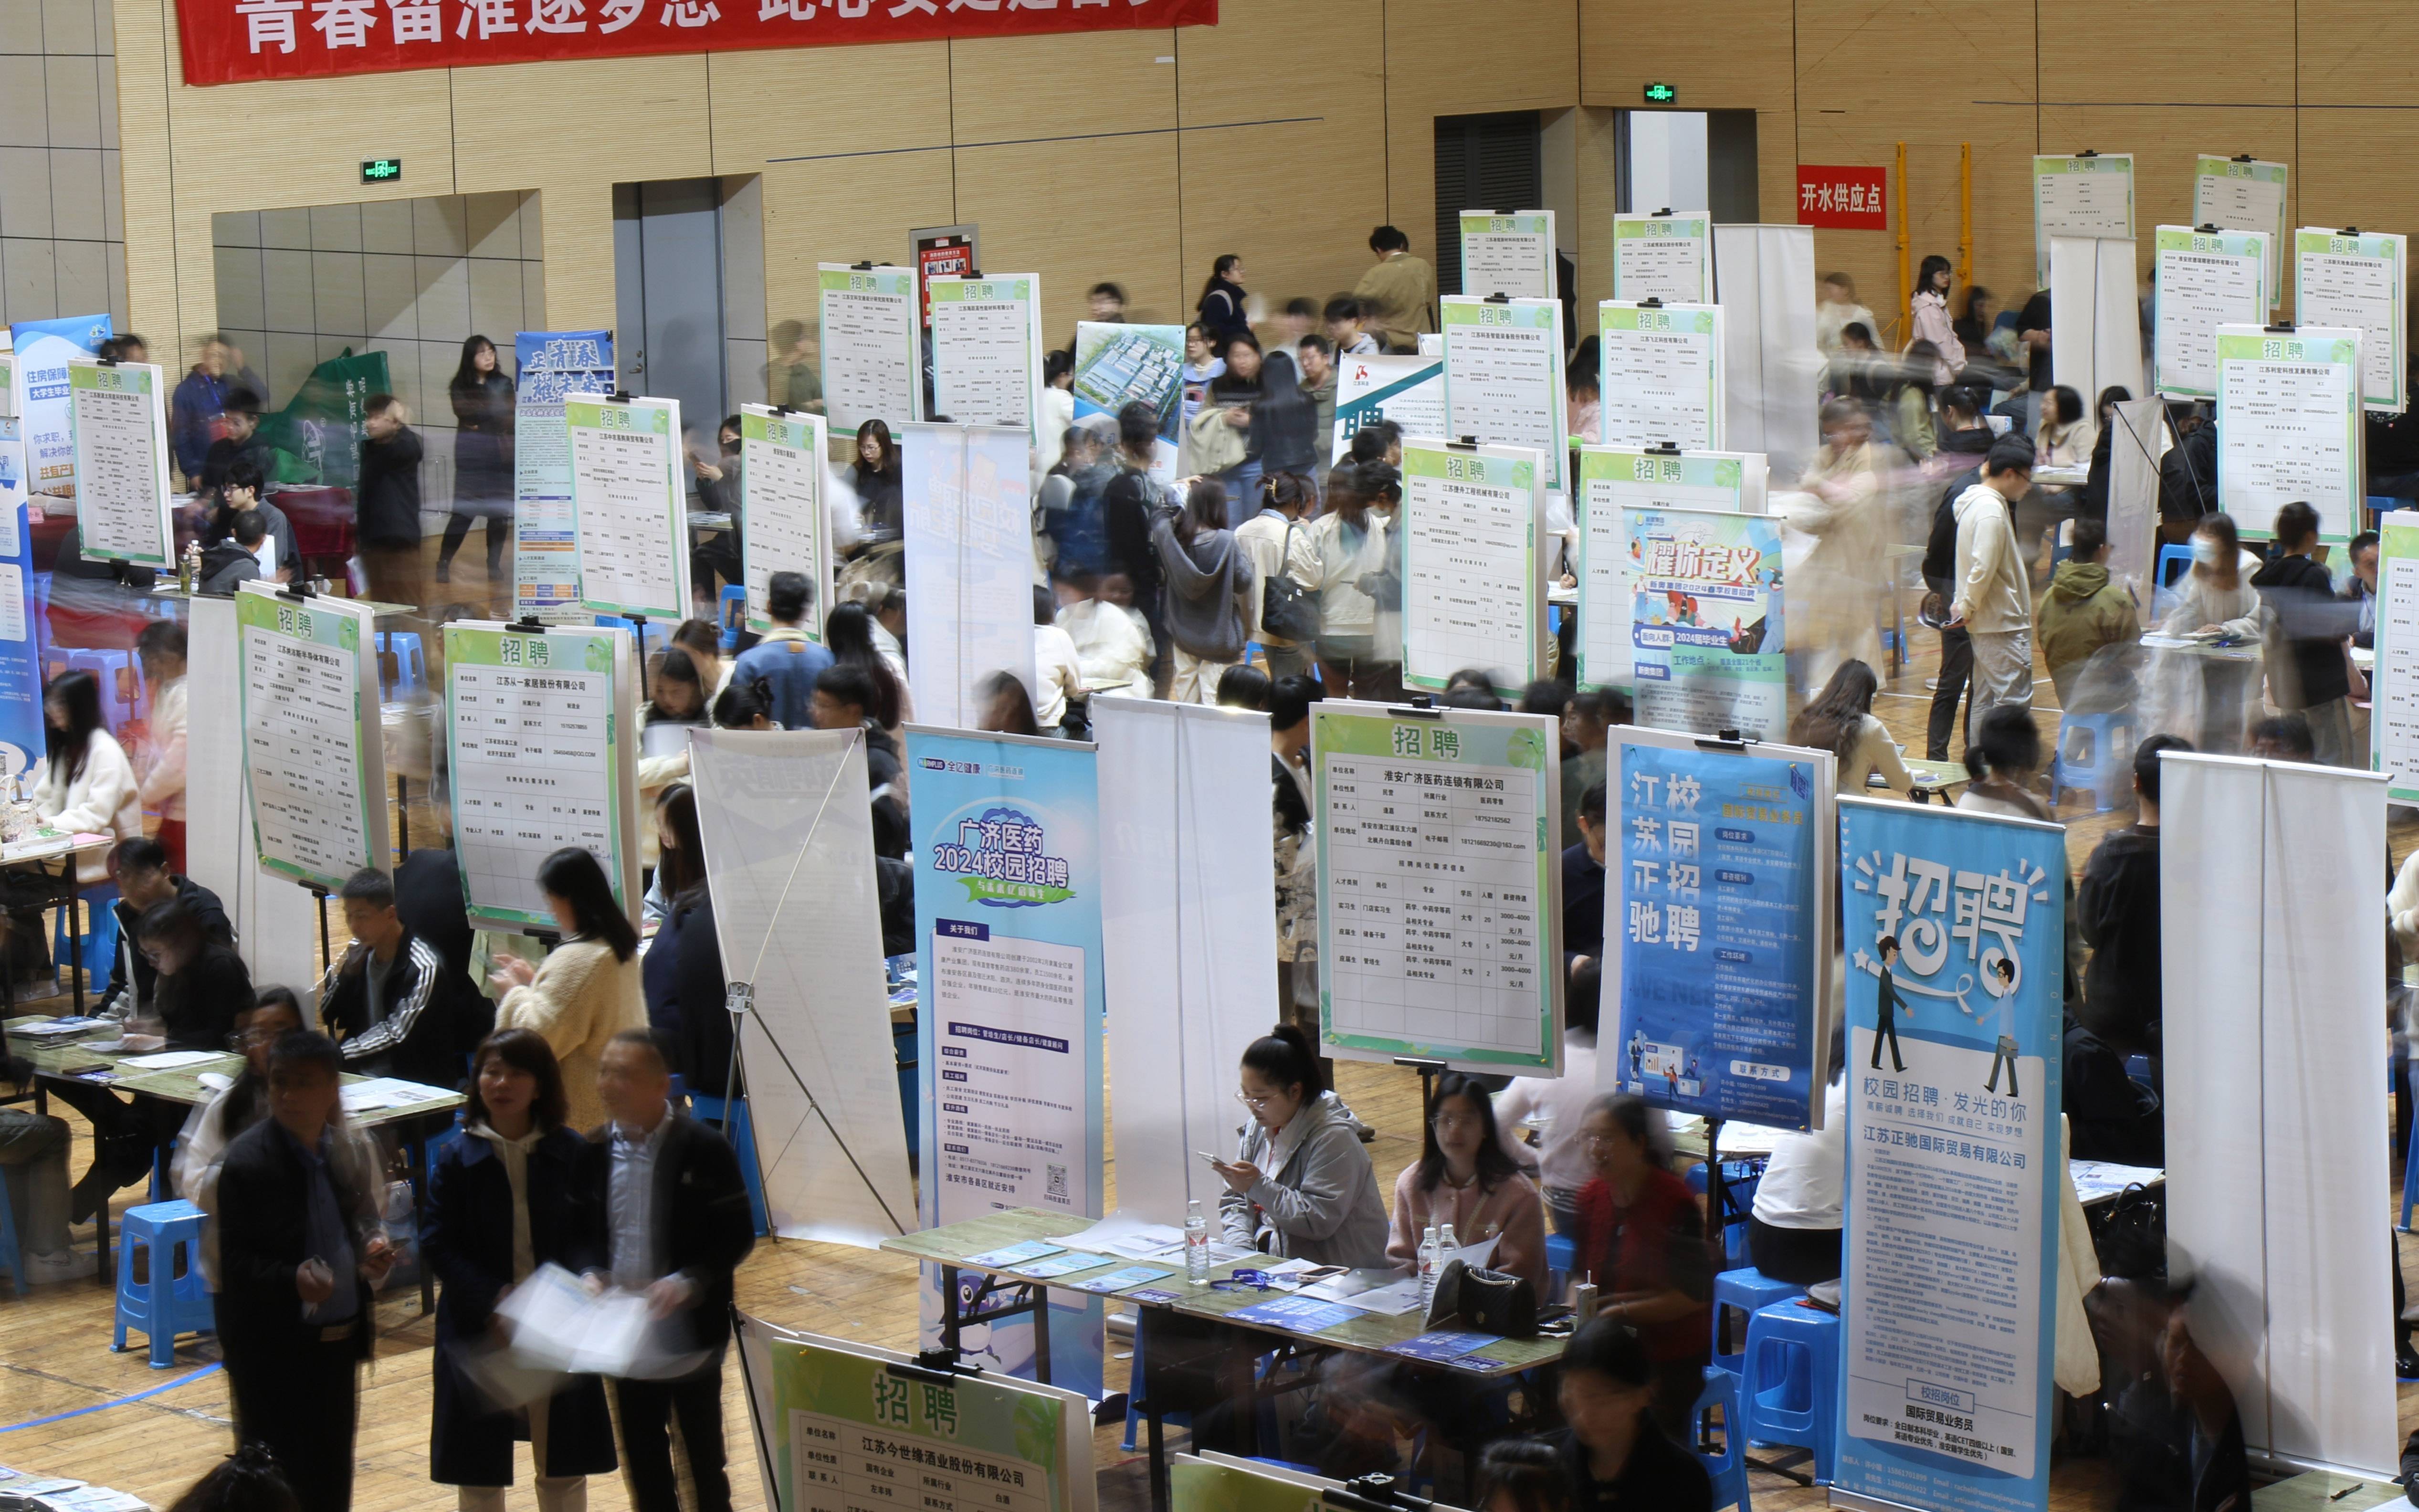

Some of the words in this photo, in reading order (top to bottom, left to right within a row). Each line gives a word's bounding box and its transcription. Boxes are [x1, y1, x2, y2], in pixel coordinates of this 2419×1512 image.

[2069, 161, 2095, 171] 招聘
[2229, 165, 2253, 178] 招聘
[1802, 183, 1881, 213] 开水供应点
[1491, 219, 1516, 231] 招聘
[1647, 223, 1672, 235] 招聘
[2194, 237, 2224, 252] 招聘
[2331, 239, 2360, 254] 招聘
[851, 276, 877, 291] 招聘
[965, 285, 993, 299] 招聘
[1481, 308, 1512, 325] 招聘
[1639, 313, 1670, 329] 招聘
[529, 339, 599, 369] 正青春
[2264, 341, 2303, 359] 招聘
[26, 367, 70, 383] 住房保障
[98, 372, 122, 388] 招聘
[2259, 367, 2330, 376] 江苏利宏科技发展有限公司
[32, 386, 71, 398] 大学生毕业
[601, 409, 630, 428] 招聘
[768, 422, 788, 443] 招聘
[1447, 457, 1485, 480] 招聘
[1636, 459, 1682, 481] 招聘
[279, 607, 312, 637] 招聘
[1676, 632, 1727, 646] 2024届毕业生
[502, 639, 549, 665] 招聘
[1638, 666, 1663, 677] 新奥集团
[496, 676, 586, 691] 江苏从一家居股份有限公司
[1393, 725, 1460, 758] 招聘
[947, 761, 981, 775] 全亿健康
[1332, 766, 1355, 775] 单位名称
[1384, 770, 1504, 790] 淮安广济医药连锁有限公司
[1333, 785, 1355, 793] 单位性质
[1424, 793, 1447, 801] 所属行业
[1480, 797, 1504, 806] 医药零售
[1333, 802, 1356, 811] 联系人
[1424, 810, 1448, 819] 联系方式
[1723, 803, 1803, 825] 国际贸易业务员
[958, 818, 1043, 856] 广济医药
[1334, 826, 1357, 835] 单位地址
[1425, 834, 1449, 843] 电子邮箱
[1722, 830, 1747, 840] 岗位要求
[1399, 860, 1465, 872] 招聘岗位需求信息
[1629, 770, 1662, 944] 江苏正驰
[1665, 772, 1701, 952] 校园招聘
[933, 846, 1069, 888] 2024校园招聘
[1722, 872, 1747, 883] 薪资福利
[1335, 878, 1358, 886] 人才类别
[1423, 886, 1434, 894] 专业
[1482, 892, 1493, 900] 人数
[1504, 893, 1526, 902] 薪资待遇
[1338, 902, 1356, 910] 实习生
[1363, 903, 1391, 914] 门店实习生
[1461, 914, 1472, 922] 大专
[950, 924, 978, 935] 关于我们
[1406, 917, 1434, 927] 品相关专业
[1509, 927, 1523, 935] 元/月
[1875, 852, 2029, 998] 招聘
[1339, 928, 1356, 936] 应届生
[1363, 930, 1386, 939] 储备干部
[1461, 940, 1473, 948] 大专
[1406, 943, 1434, 953] 品相关专业
[1509, 952, 1523, 961] 元/月
[1721, 951, 1745, 961] 工作环境
[1339, 956, 1357, 964] 应届生
[1363, 957, 1380, 966] 管培生
[1462, 967, 1473, 976] 大专
[1406, 970, 1435, 979] 品相关专业
[1739, 1064, 1779, 1078] 联系方式
[1866, 1101, 1903, 1116] 高薪诚聘
[1908, 1107, 1944, 1123] 选择我们
[1948, 1115, 1982, 1130] 成就自己
[1987, 1122, 2022, 1137] 实现梦想
[1863, 1124, 2026, 1169] 江苏正驰国际贸易有限公司
[946, 1173, 1015, 1194] 淮安市各县区就近安排
[874, 1374, 957, 1434] 招聘
[1921, 1385, 1960, 1406] 校招岗位
[1905, 1405, 1973, 1432] 国际贸易业务员
[807, 1427, 836, 1441] 单位名称
[862, 1437, 1024, 1488] 江苏今世缘酒业股份有限公司
[808, 1451, 837, 1465] 单位性质
[866, 1463, 894, 1478] 国有企业
[923, 1476, 952, 1491] 所属行业
[808, 1470, 838, 1484] 联系人
[995, 1493, 1010, 1505] 白酒
[924, 1496, 954, 1512] 联系方式
